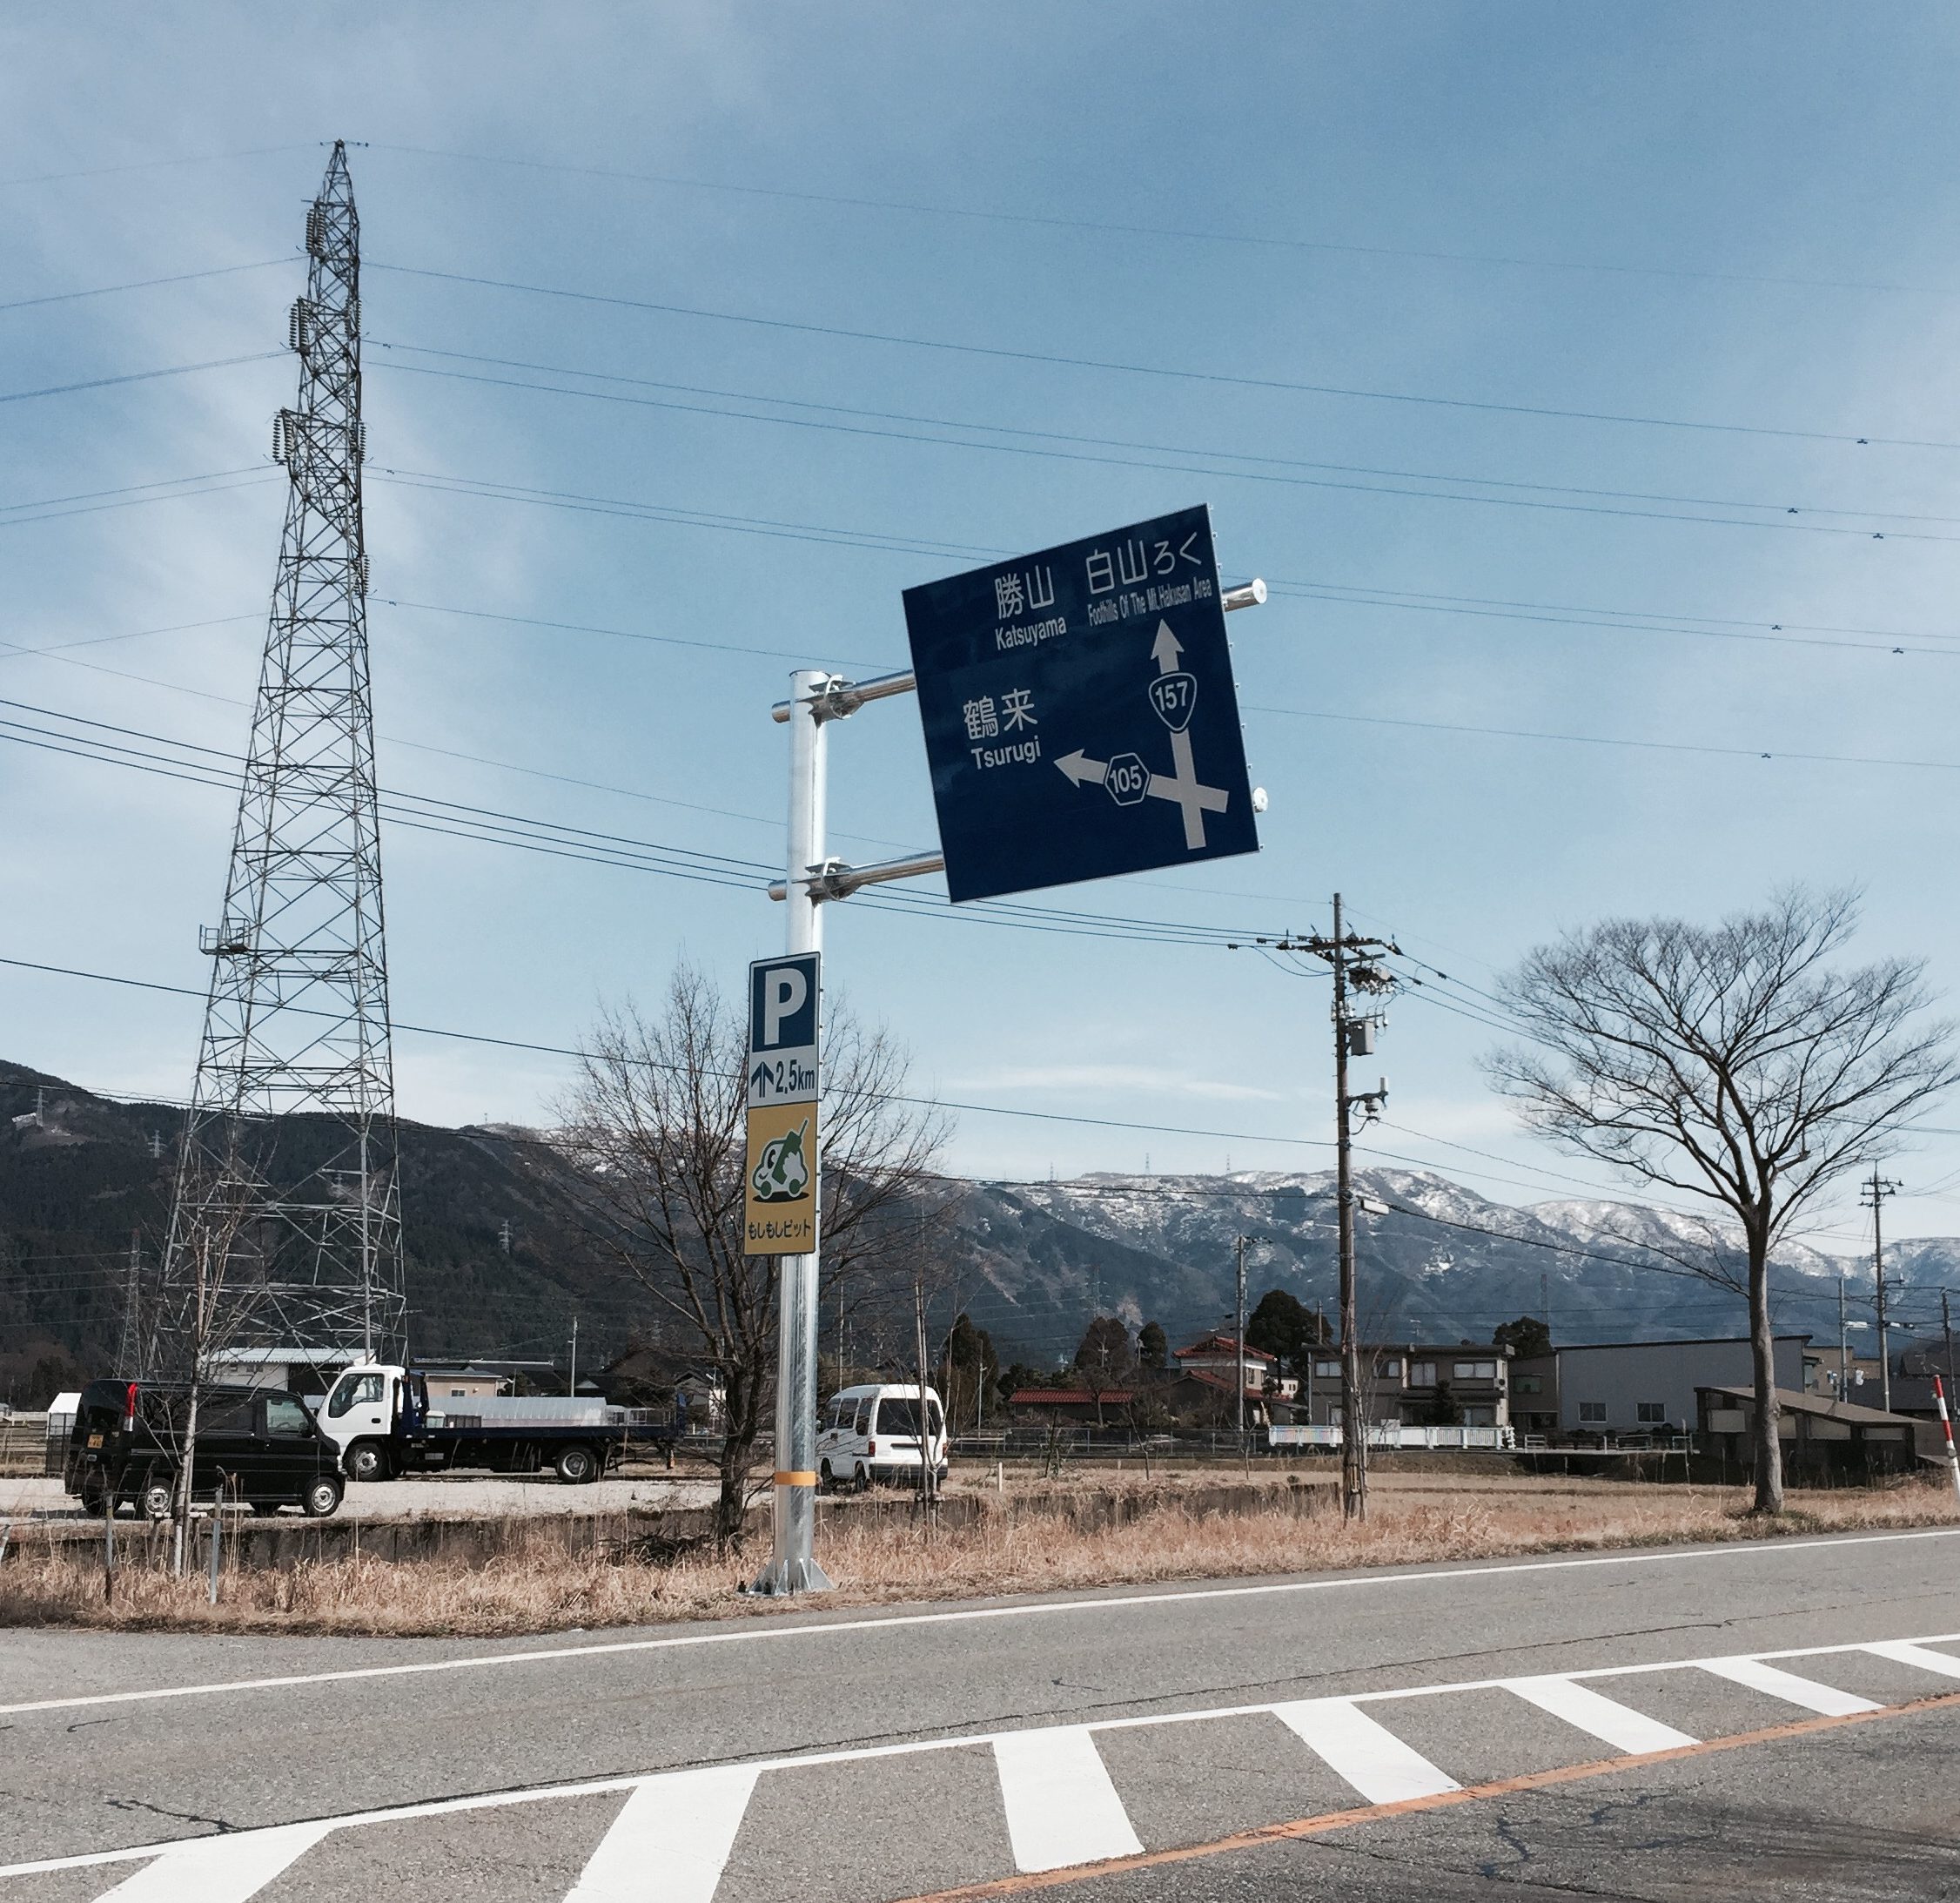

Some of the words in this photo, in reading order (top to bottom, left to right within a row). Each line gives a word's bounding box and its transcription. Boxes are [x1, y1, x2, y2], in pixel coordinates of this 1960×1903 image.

[1085, 531, 1203, 595] 白山ろく
[994, 564, 1055, 621] 勝山
[1088, 598, 1118, 627] Foothills
[1119, 595, 1130, 619] Of
[1131, 591, 1146, 615] The
[1193, 576, 1212, 600] Area
[995, 615, 1068, 651] Katsuyama
[963, 688, 1038, 740] 鶴来
[1155, 681, 1189, 711] 157
[971, 735, 1041, 770] Tsurugi
[1110, 764, 1143, 794] 105
[764, 967, 808, 1046] P
[748, 1219, 811, 1241] もしもしピット
